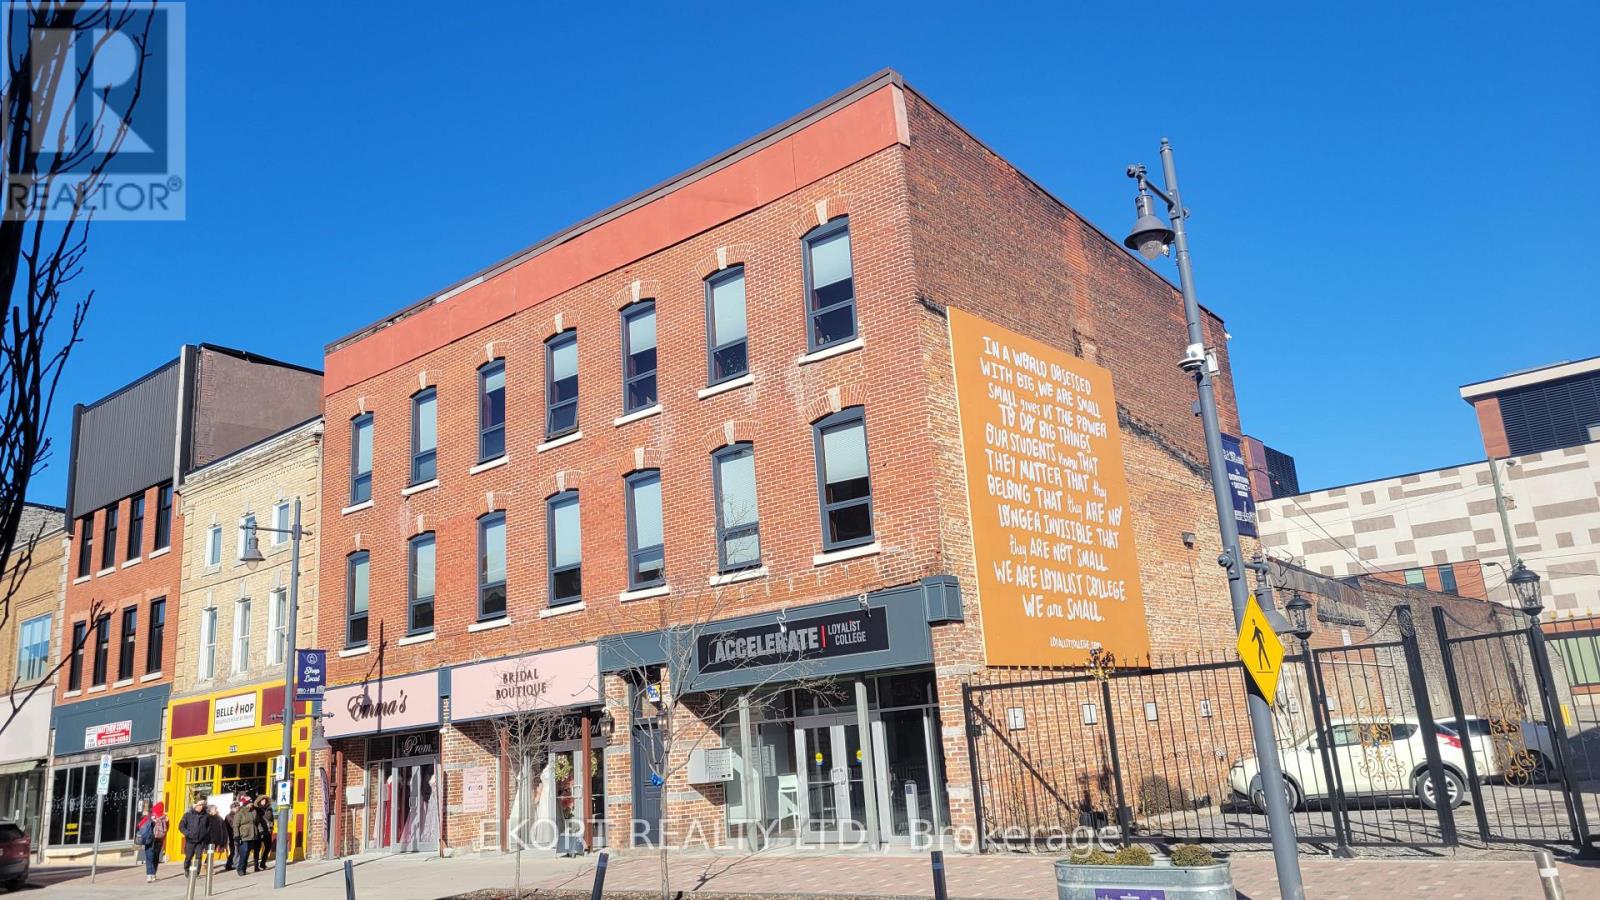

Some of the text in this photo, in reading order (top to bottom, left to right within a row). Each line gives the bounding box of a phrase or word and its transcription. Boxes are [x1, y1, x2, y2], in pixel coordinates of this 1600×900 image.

[982, 336, 1092, 395] IN A WORLD OBSESSED
[980, 356, 1013, 385] WITH
[1038, 380, 1054, 397] WE
[1056, 387, 1073, 407] ARE
[1077, 395, 1101, 418] SMALL
[988, 382, 1018, 407] SMALL
[1043, 404, 1053, 420] US
[1056, 406, 1074, 428] THE
[1077, 414, 1108, 439] POWER
[998, 403, 1016, 427] TO
[1020, 412, 1036, 434] DO
[1039, 420, 1056, 441] BIG
[986, 422, 1009, 450] OUR
[1010, 432, 1057, 462] STUDENTS
[1077, 451, 1099, 477] THAT
[985, 448, 1016, 478] THEY
[1020, 460, 1063, 488] MATTER
[1064, 469, 1089, 493] THAT
[987, 474, 1031, 505] BELONG
[1034, 486, 1063, 512] THAT
[1086, 500, 1105, 524] ARE
[1107, 505, 1123, 527] NO
[998, 503, 1042, 533] LONGER
[1096, 527, 1120, 549] THAT
[1030, 536, 1050, 560] ARE
[1053, 542, 1073, 566] NOT
[994, 559, 1013, 585] WE
[1016, 564, 1038, 589] ARE
[1040, 567, 1082, 595] LOYALIST
[1023, 593, 1105, 622] WE are SMALL.
[714, 625, 820, 663] ACCELERATE
[828, 620, 861, 635] LOYALIST
[834, 631, 867, 646] COLLEGE
[496, 682, 547, 700] BOUTIQUE
[503, 669, 539, 685] BRIDAL
[216, 703, 254, 718] BELLE HOP
[347, 689, 408, 722] Emma's
